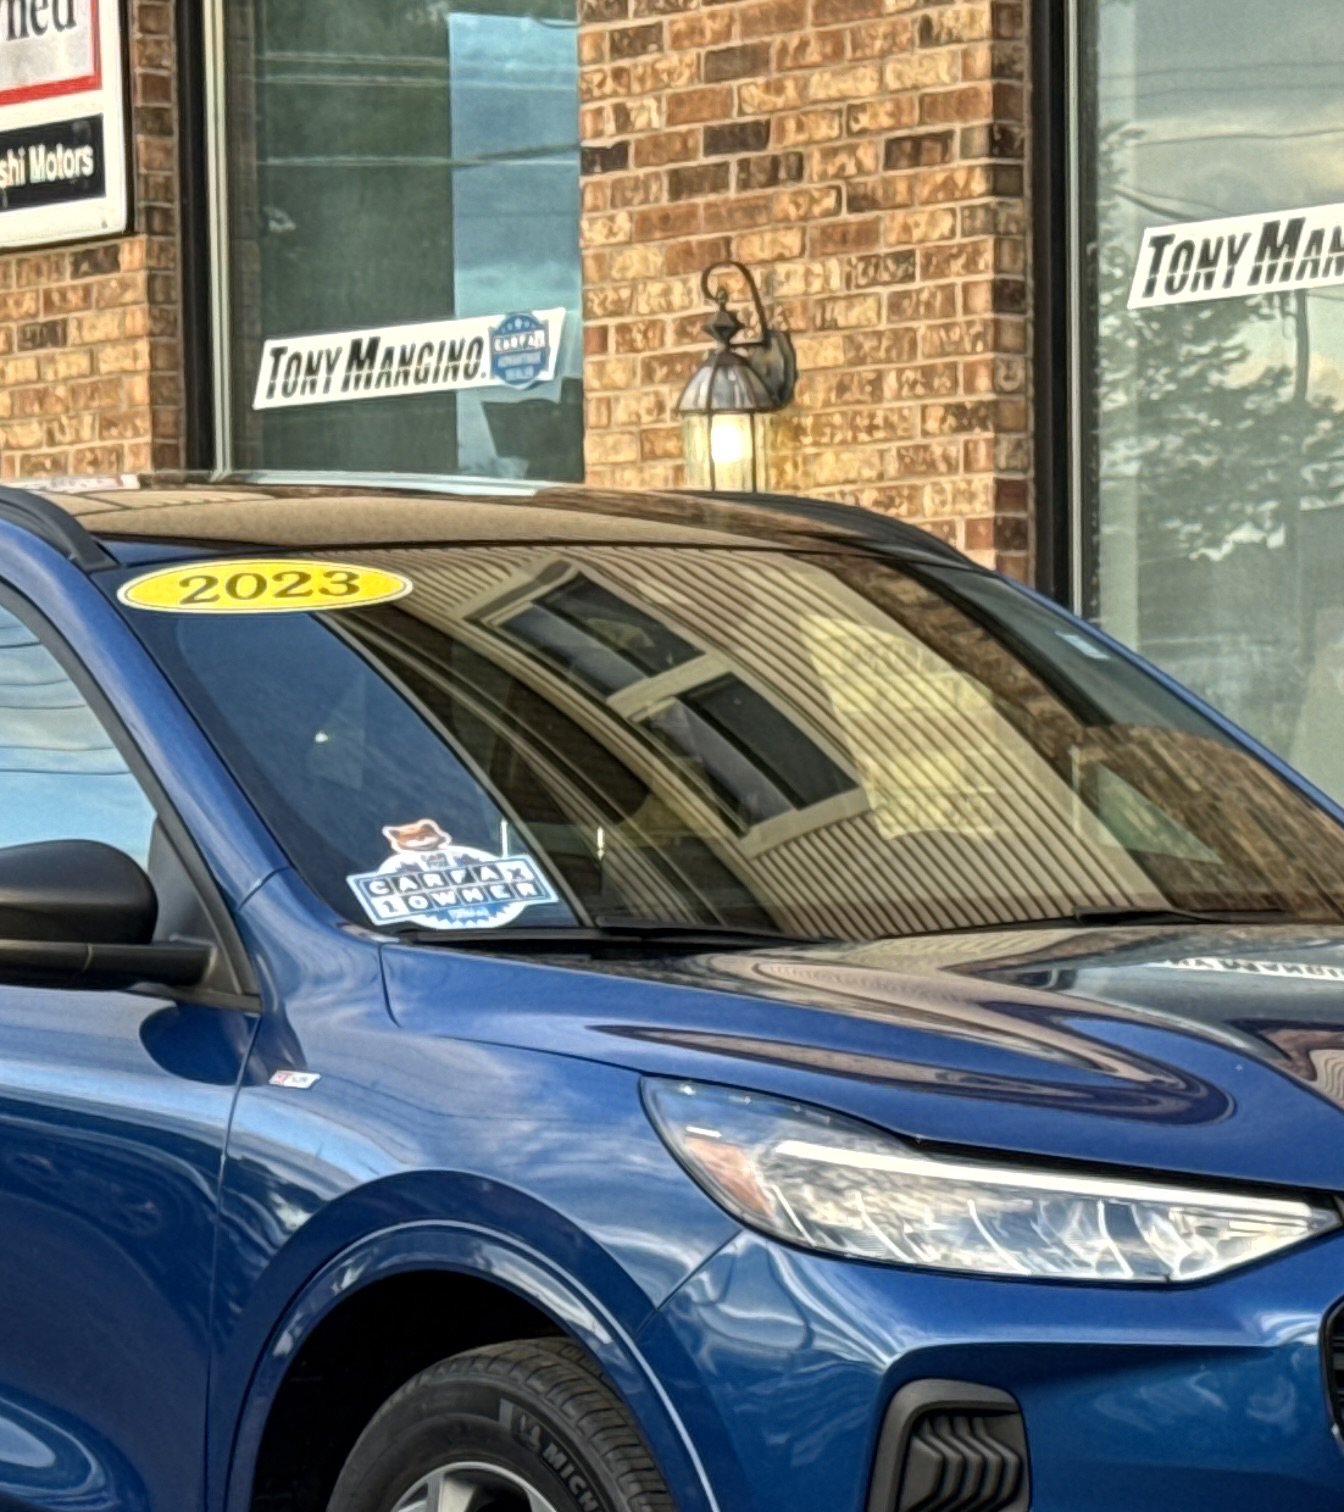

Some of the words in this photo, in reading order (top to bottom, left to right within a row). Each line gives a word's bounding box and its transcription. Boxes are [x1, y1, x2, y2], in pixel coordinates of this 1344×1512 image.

[28, 143, 94, 185] Motors
[1141, 230, 1252, 298] TONY
[265, 346, 344, 400] TONY
[178, 570, 360, 605] 2023
[367, 864, 528, 896] CARFAX
[408, 881, 539, 910] OWNER
